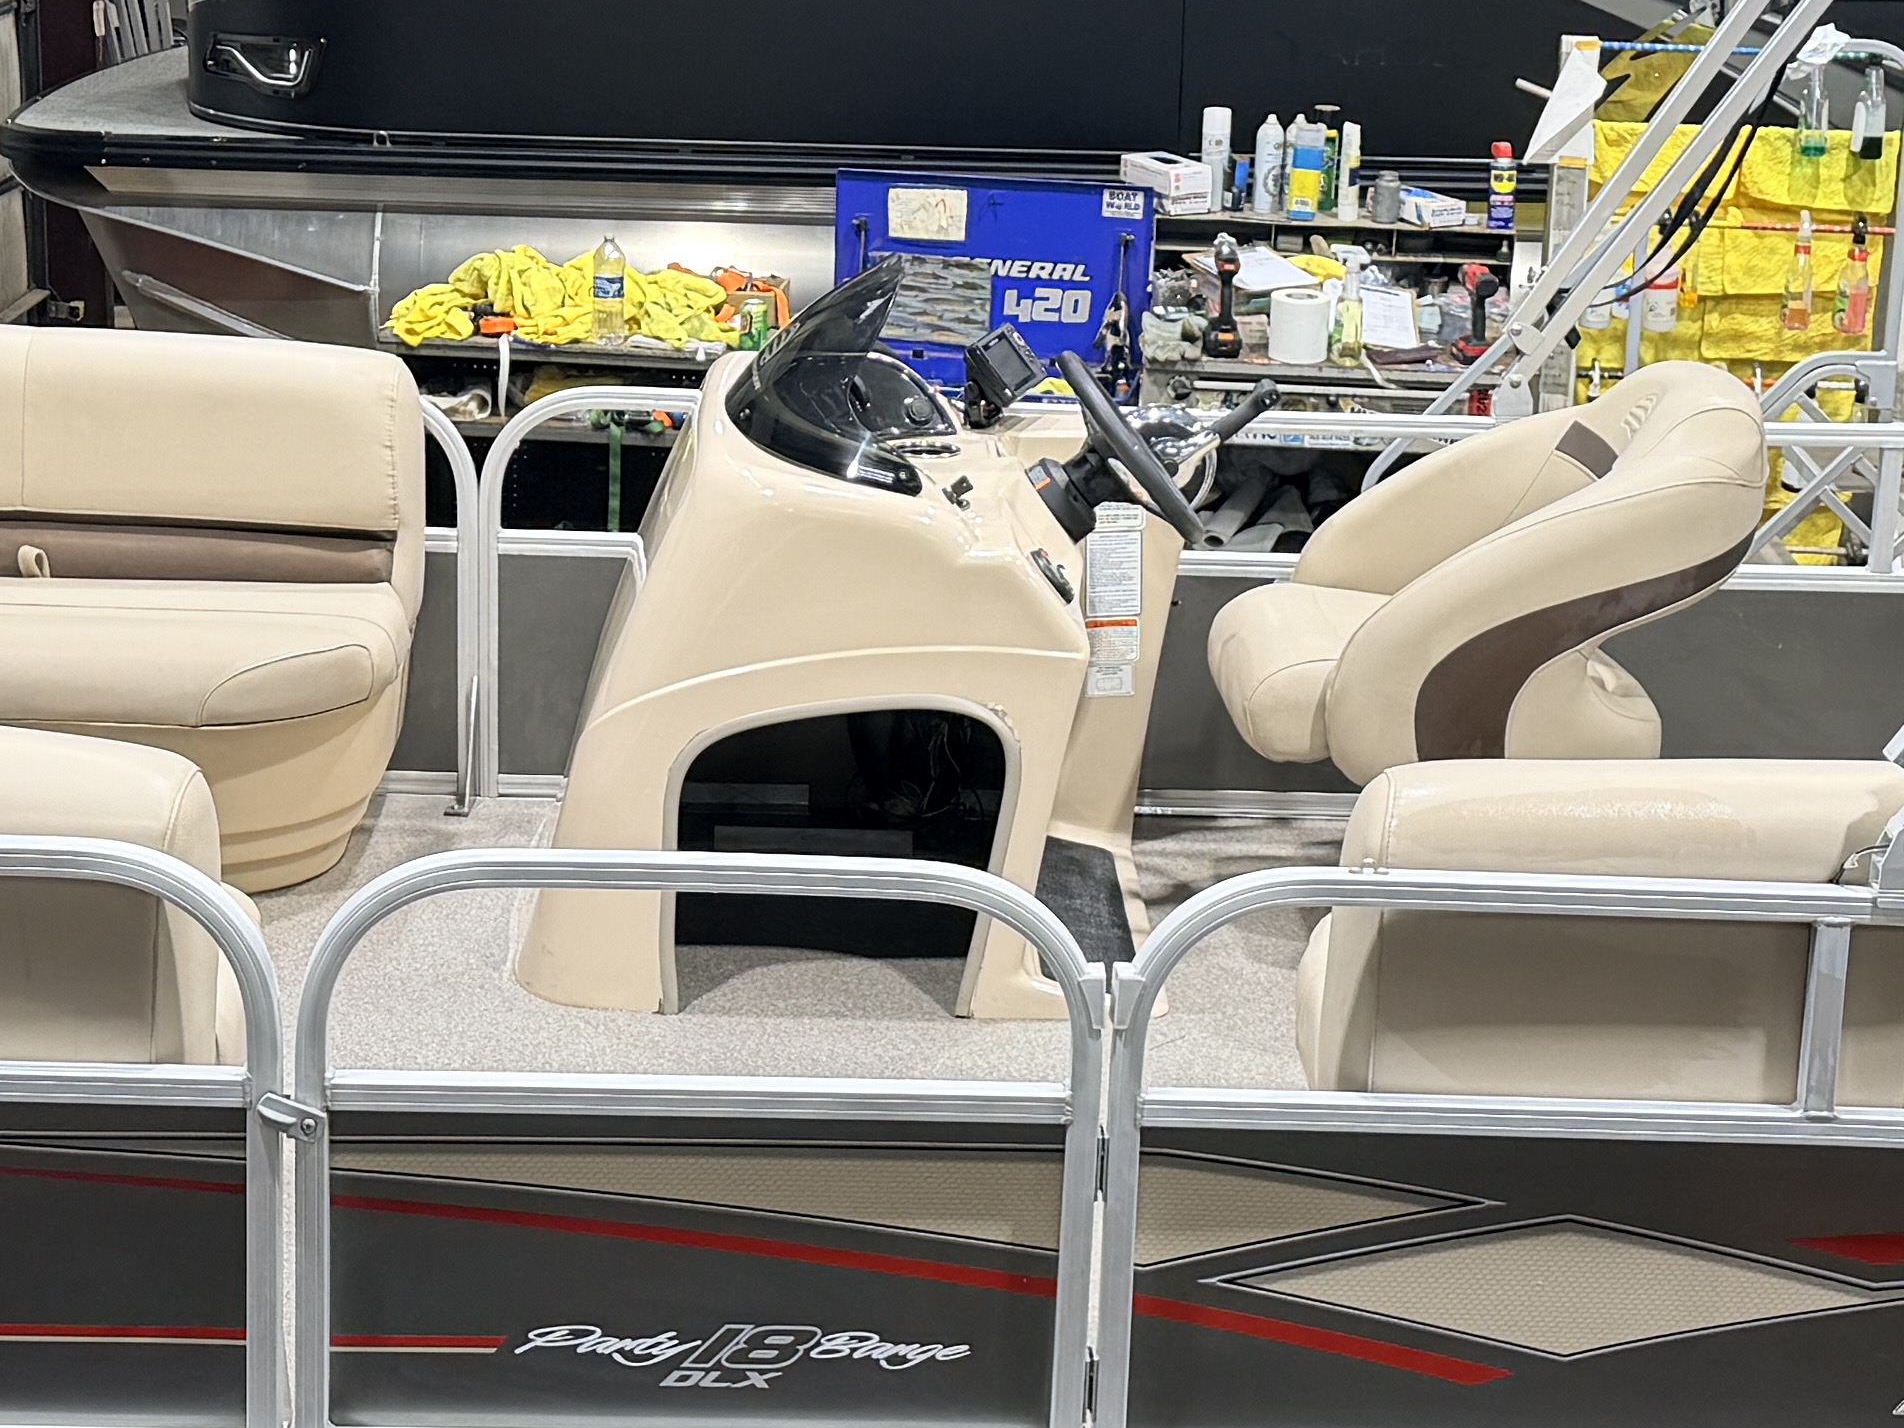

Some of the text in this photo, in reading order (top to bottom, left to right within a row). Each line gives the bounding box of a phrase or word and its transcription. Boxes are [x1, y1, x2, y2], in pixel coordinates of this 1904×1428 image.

[1108, 190, 1138, 202] BOAT
[953, 256, 1091, 281] NERAL
[1003, 287, 1092, 324] 420
[514, 1323, 974, 1371] Party 18 Barge
[658, 1370, 784, 1390] DLX
